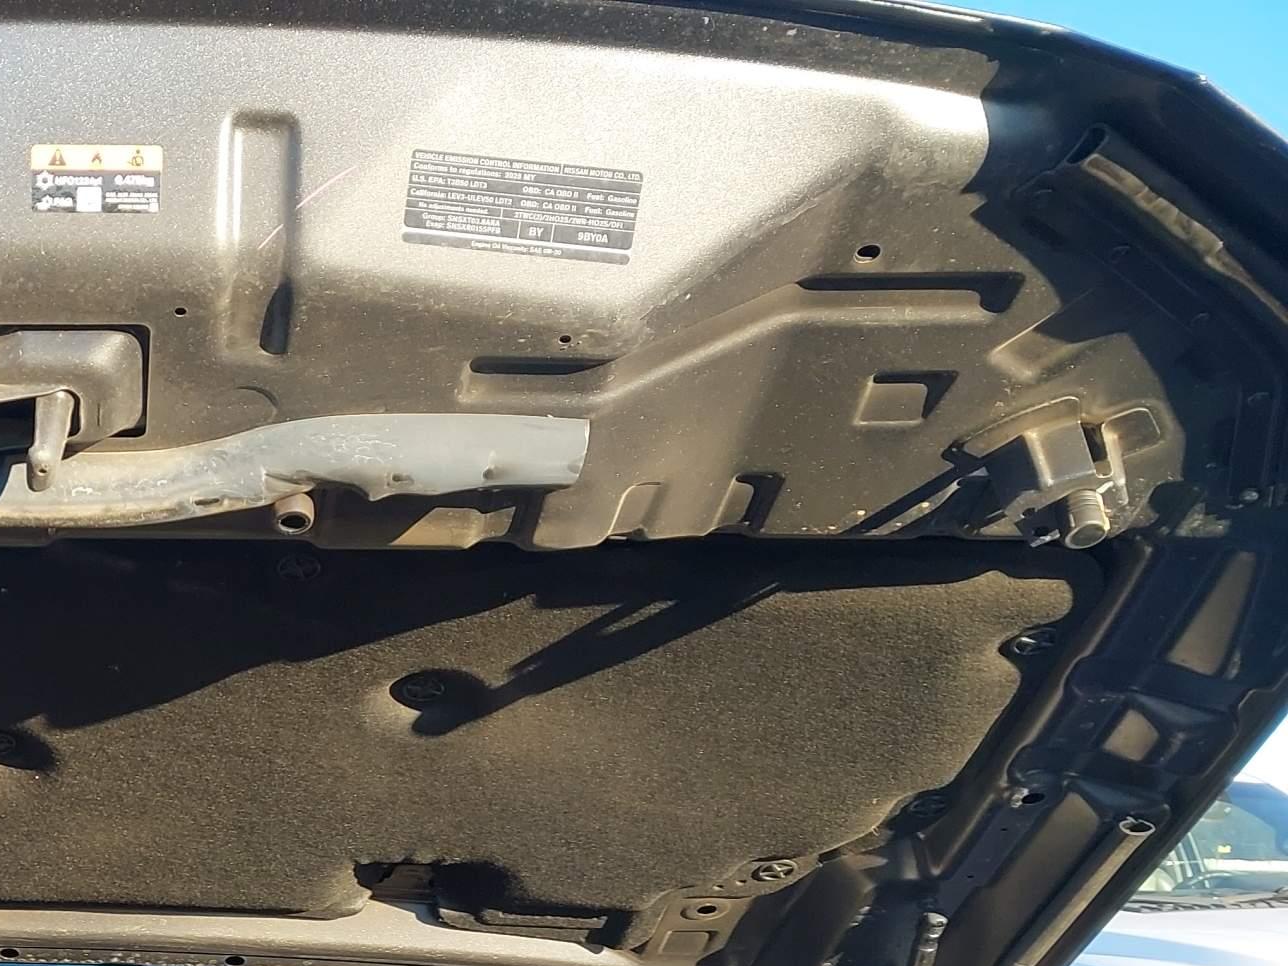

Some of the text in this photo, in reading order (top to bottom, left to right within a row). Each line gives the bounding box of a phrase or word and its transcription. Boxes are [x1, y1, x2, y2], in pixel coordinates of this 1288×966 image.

[414, 162, 448, 172] Conforms
[459, 167, 501, 177] regulations:
[523, 173, 536, 181] MY
[415, 152, 560, 173] VEHICLE EMISSION CONTROL INFORMATION
[564, 167, 588, 175] NISSAN
[590, 170, 612, 178] MOTOR
[428, 176, 445, 184] EPA:
[608, 195, 637, 204] Gasoline
[410, 188, 446, 198] California:
[521, 200, 539, 208] OBD:
[555, 203, 570, 211] OBD
[585, 206, 602, 214] Fuel:
[606, 209, 635, 217] Gasoline
[529, 227, 544, 237] BY
